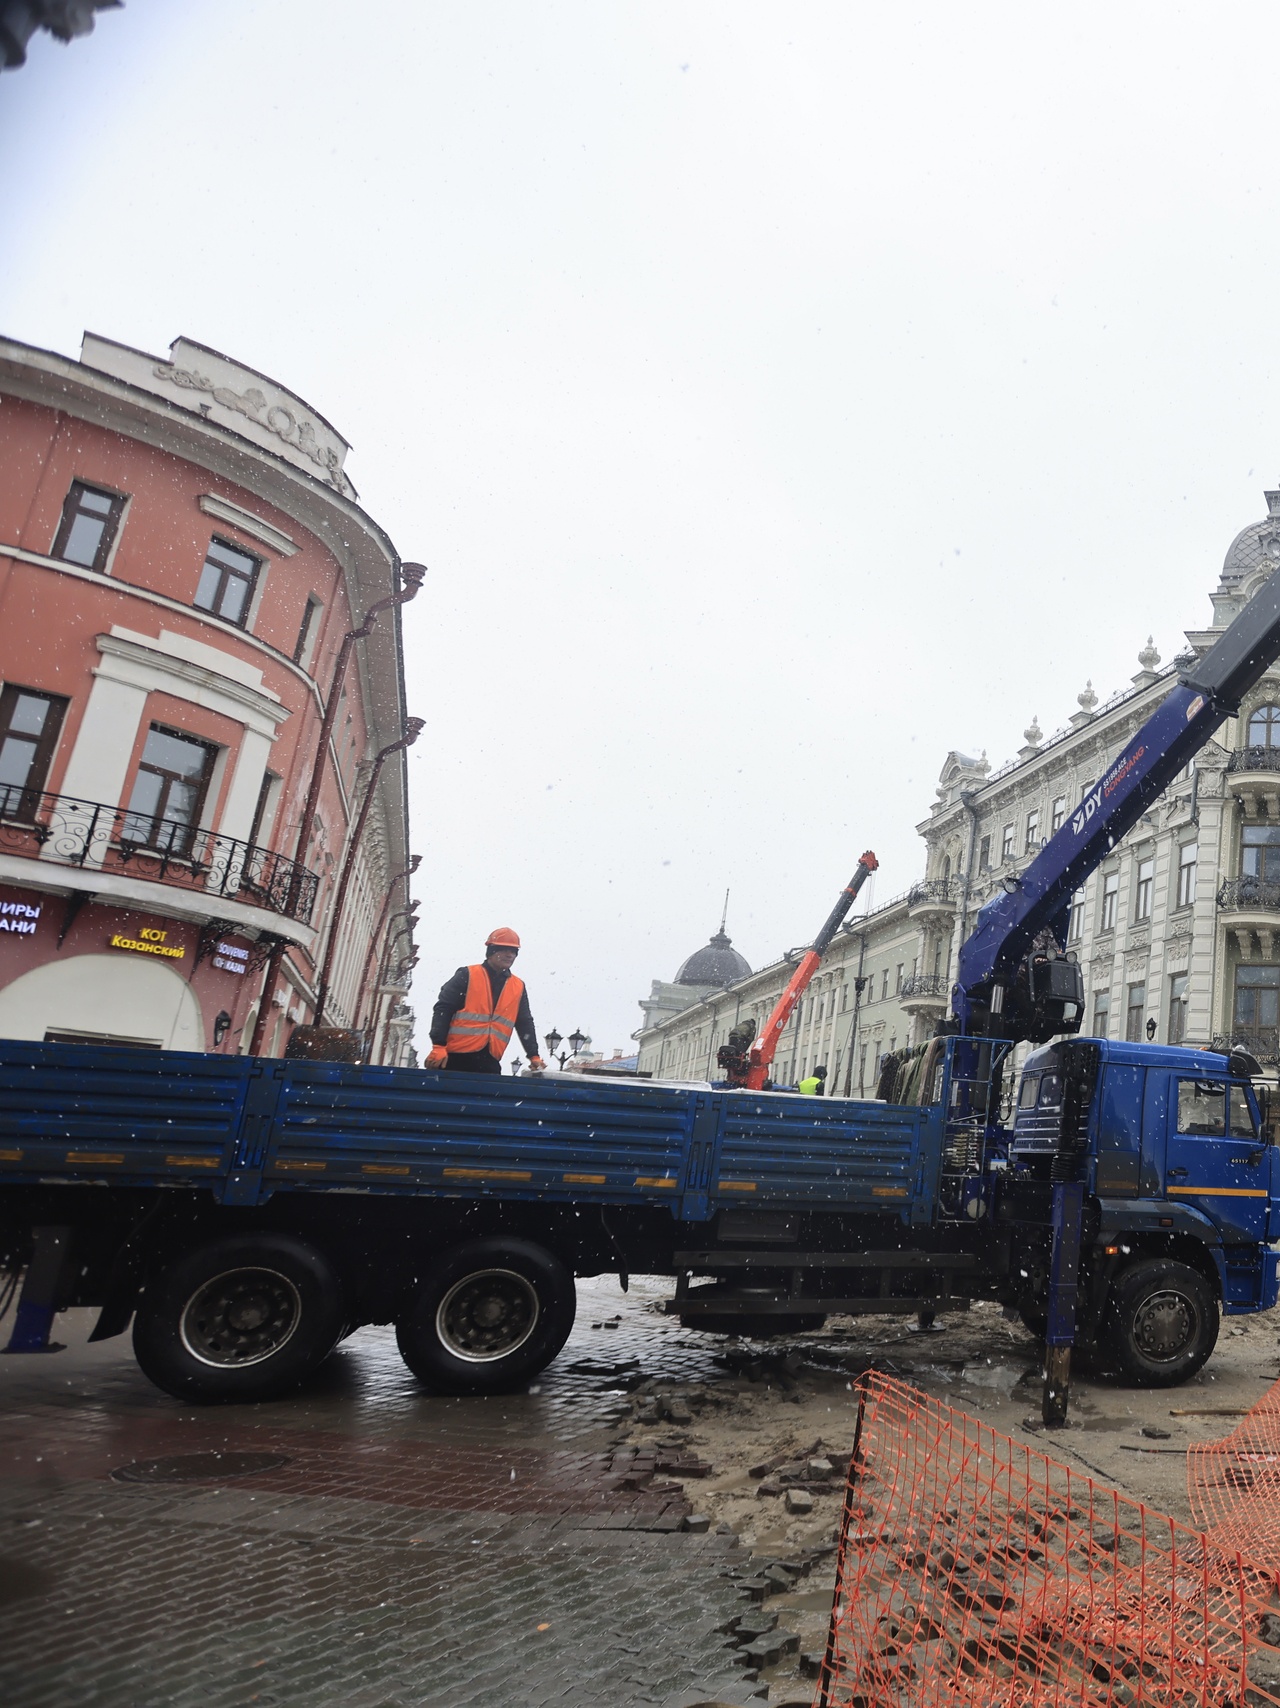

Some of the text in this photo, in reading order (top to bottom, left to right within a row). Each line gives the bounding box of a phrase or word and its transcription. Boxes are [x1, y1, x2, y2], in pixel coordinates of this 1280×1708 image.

[1104, 746, 1144, 798] DONGYANG
[0, 901, 41, 919] ИРЫ
[140, 927, 168, 942] КОТ
[111, 935, 186, 959] Казанский
